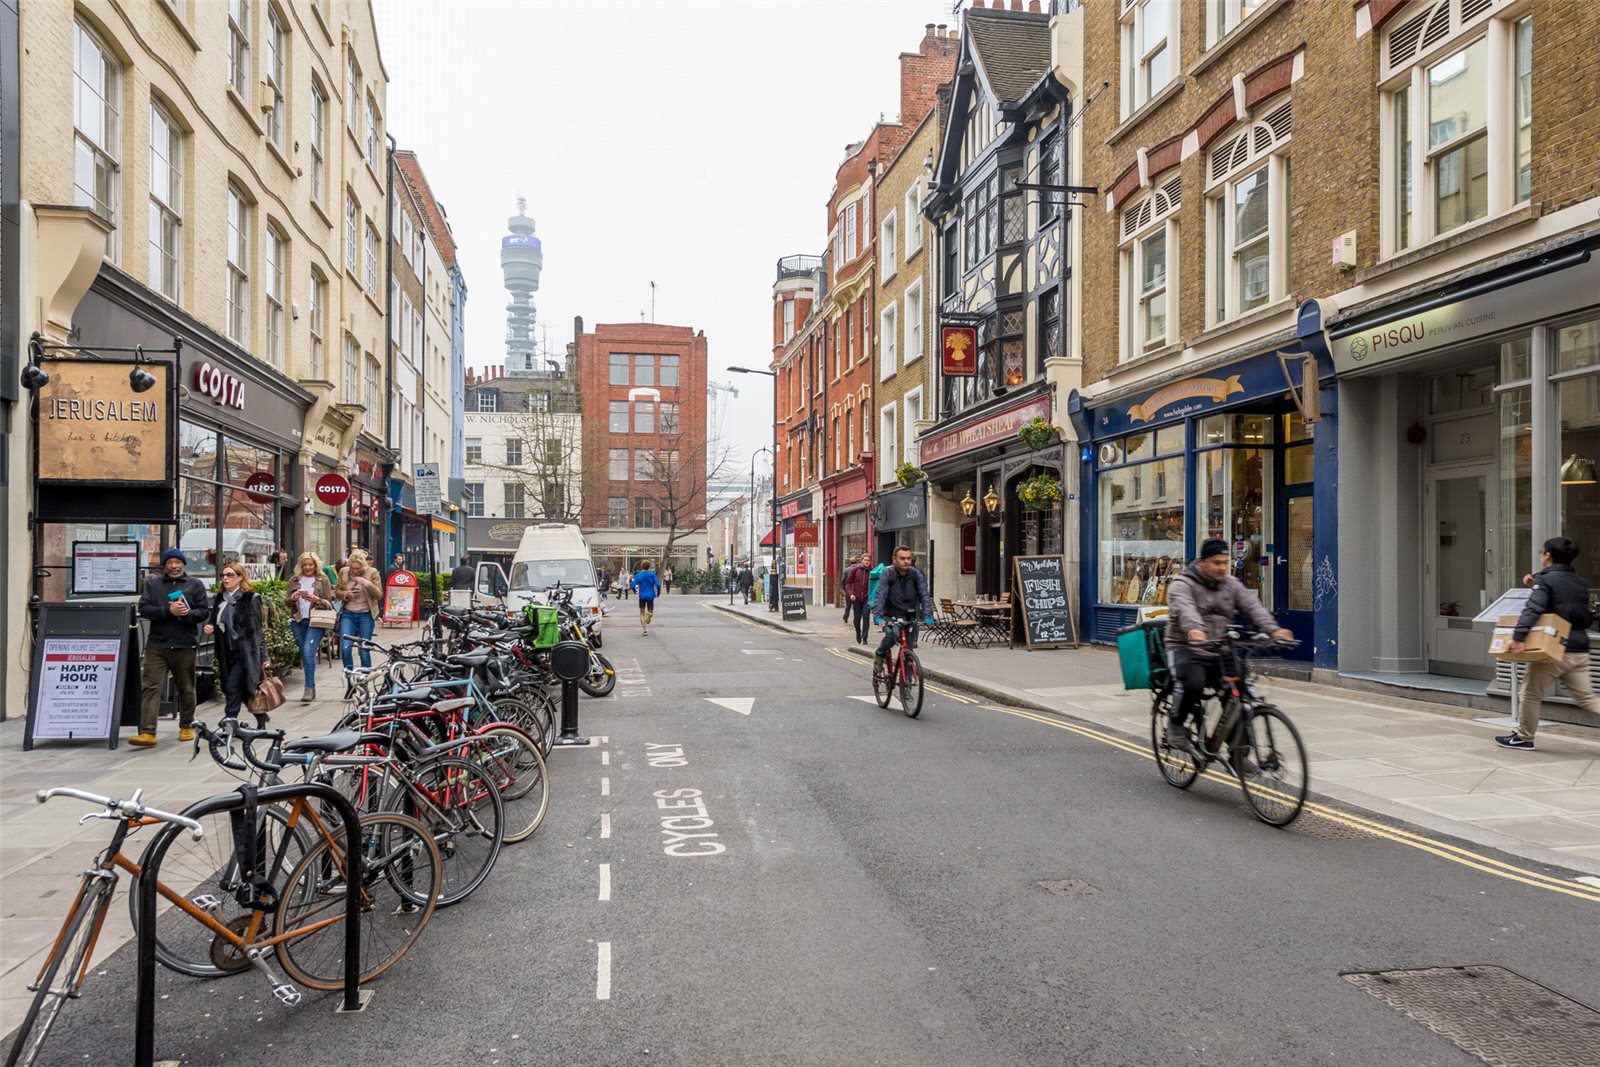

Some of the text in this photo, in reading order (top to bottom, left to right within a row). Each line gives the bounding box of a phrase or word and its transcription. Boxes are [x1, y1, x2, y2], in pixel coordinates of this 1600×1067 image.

[1372, 312, 1496, 352] PISQU PERUVIAN CUISINE
[199, 362, 245, 410] COSTA
[48, 398, 158, 422] JERUSALEM
[942, 433, 958, 452] THE
[1459, 433, 1471, 444] 23
[318, 485, 347, 493] COSTA
[1024, 579, 1061, 593] FISH
[1025, 596, 1066, 609] CHIPS
[60, 664, 99, 672] HAPPY
[60, 673, 98, 682] HOUR
[644, 742, 726, 857] CYCLES ONLY
